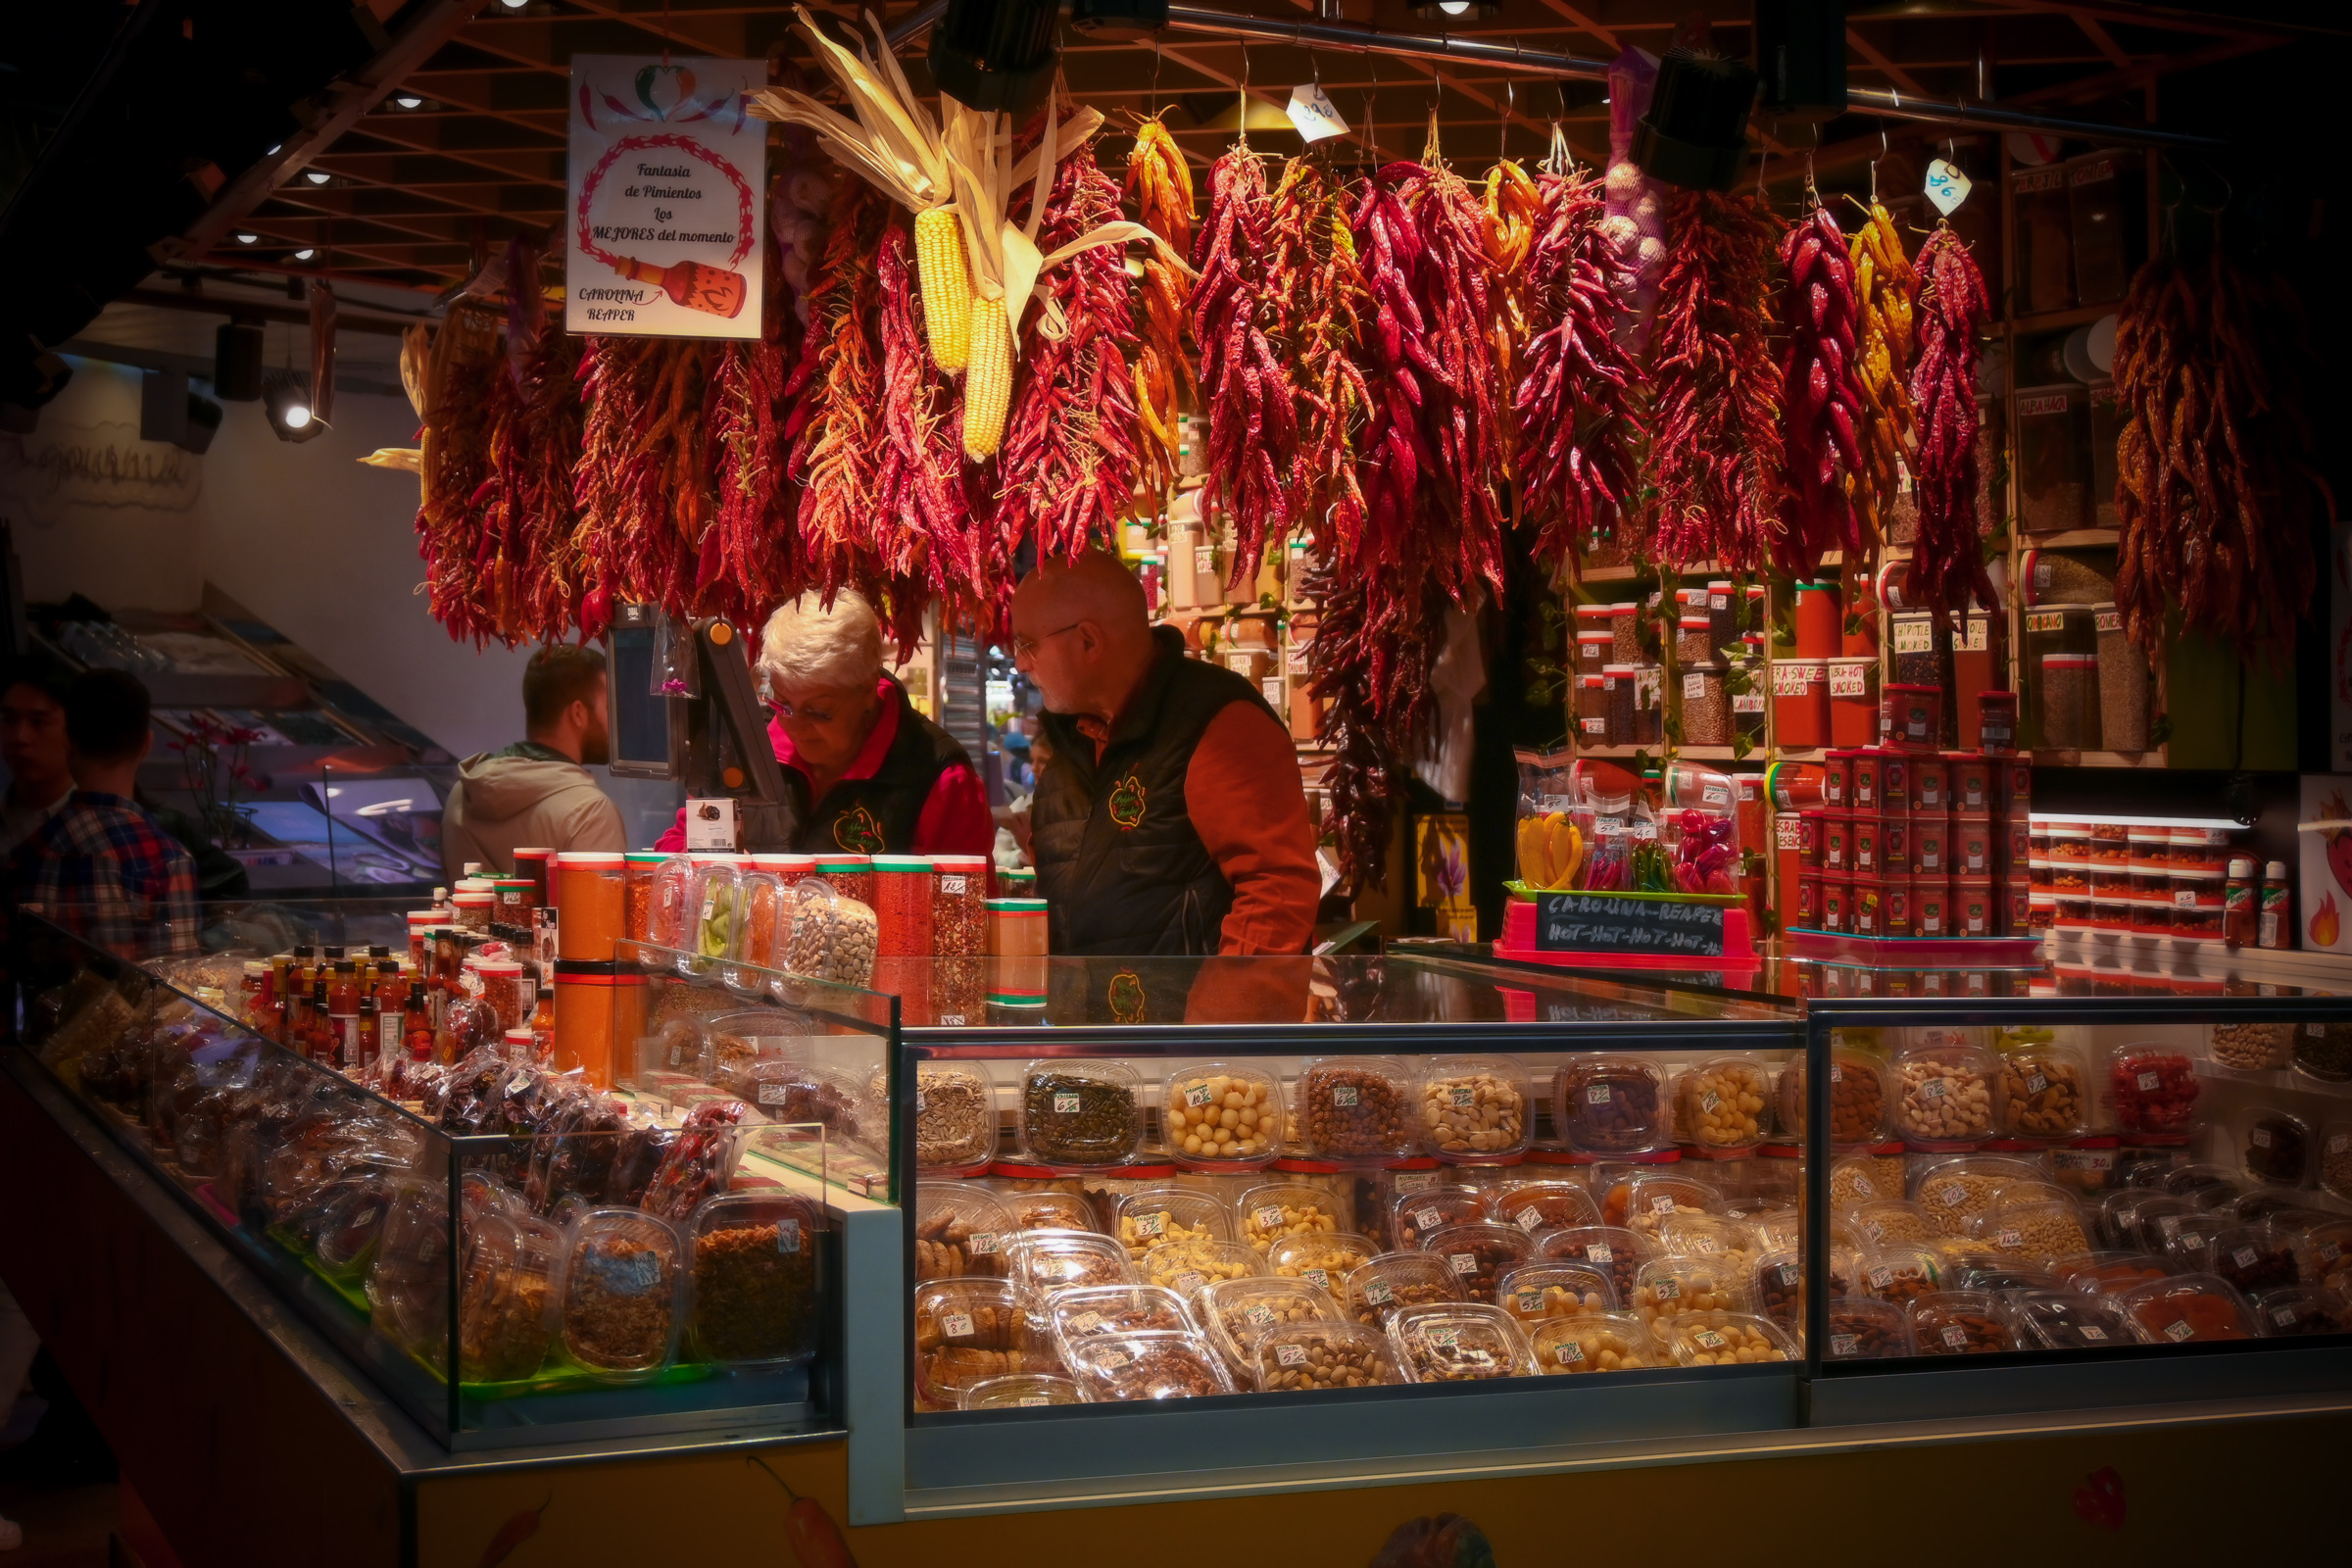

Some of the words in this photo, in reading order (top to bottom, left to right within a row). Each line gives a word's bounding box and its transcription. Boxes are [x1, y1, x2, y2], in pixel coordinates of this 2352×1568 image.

[637, 163, 691, 177] Fantasia
[624, 185, 640, 197] de
[642, 184, 703, 200] Pimientos
[654, 207, 673, 222] Los
[593, 226, 655, 242] MEJORES
[658, 229, 676, 241] del
[678, 231, 736, 243] momento
[579, 288, 644, 304] CAROLINA
[587, 308, 635, 321] REAPER
[2020, 397, 2066, 414] ALBAHACA
[1894, 622, 1930, 637] CHIPOTLE
[1896, 639, 1930, 652] SMOKED
[1773, 680, 1807, 695] SMOKED
[1832, 680, 1864, 695] SMOKED
